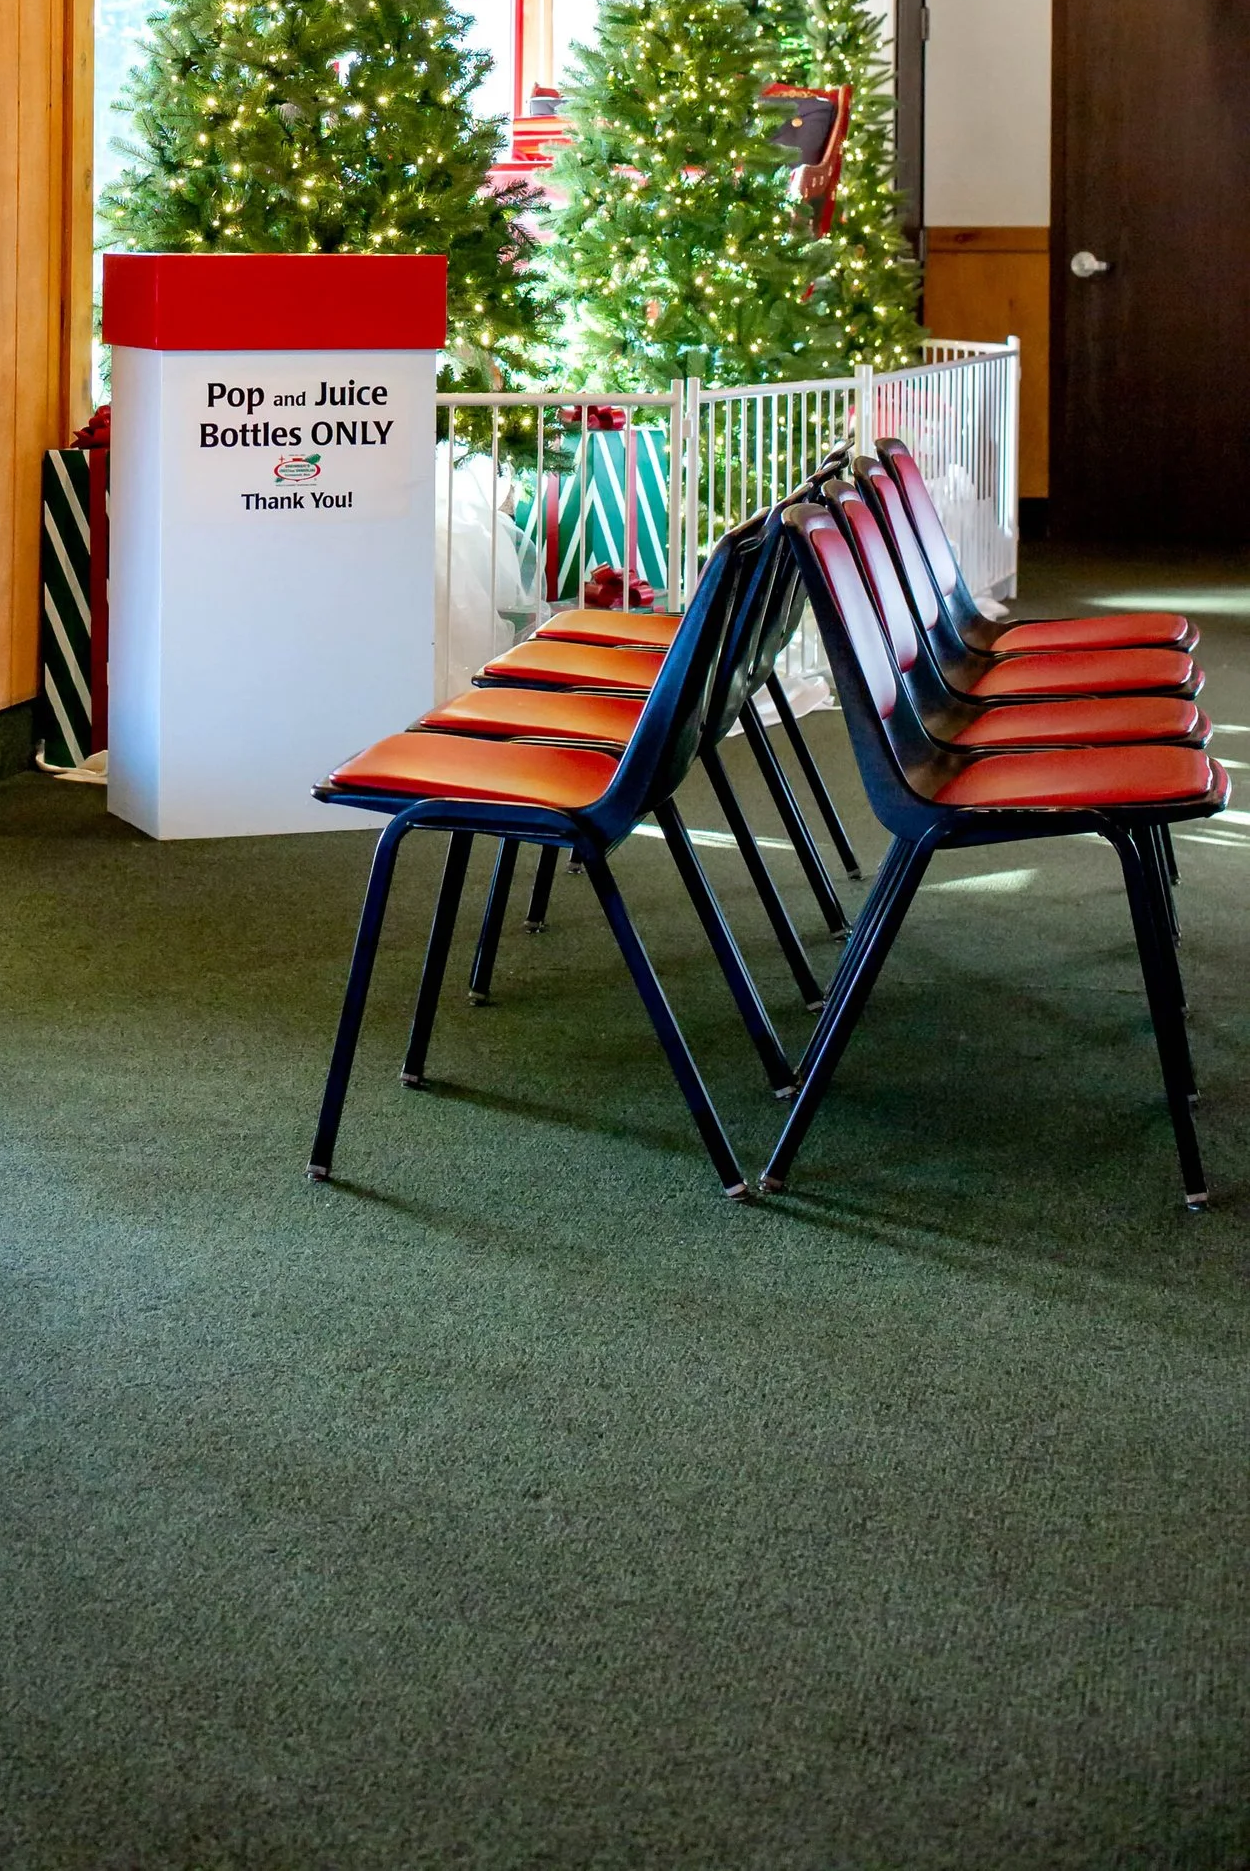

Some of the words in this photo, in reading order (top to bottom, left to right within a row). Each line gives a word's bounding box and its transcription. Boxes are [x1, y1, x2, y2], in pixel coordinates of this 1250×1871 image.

[208, 383, 264, 414] Pop
[274, 392, 305, 406] and
[315, 380, 388, 406] Juice
[200, 422, 302, 447] Bottles
[311, 421, 394, 445] ONLY
[241, 492, 304, 510] Thank
[311, 491, 352, 508] You!
